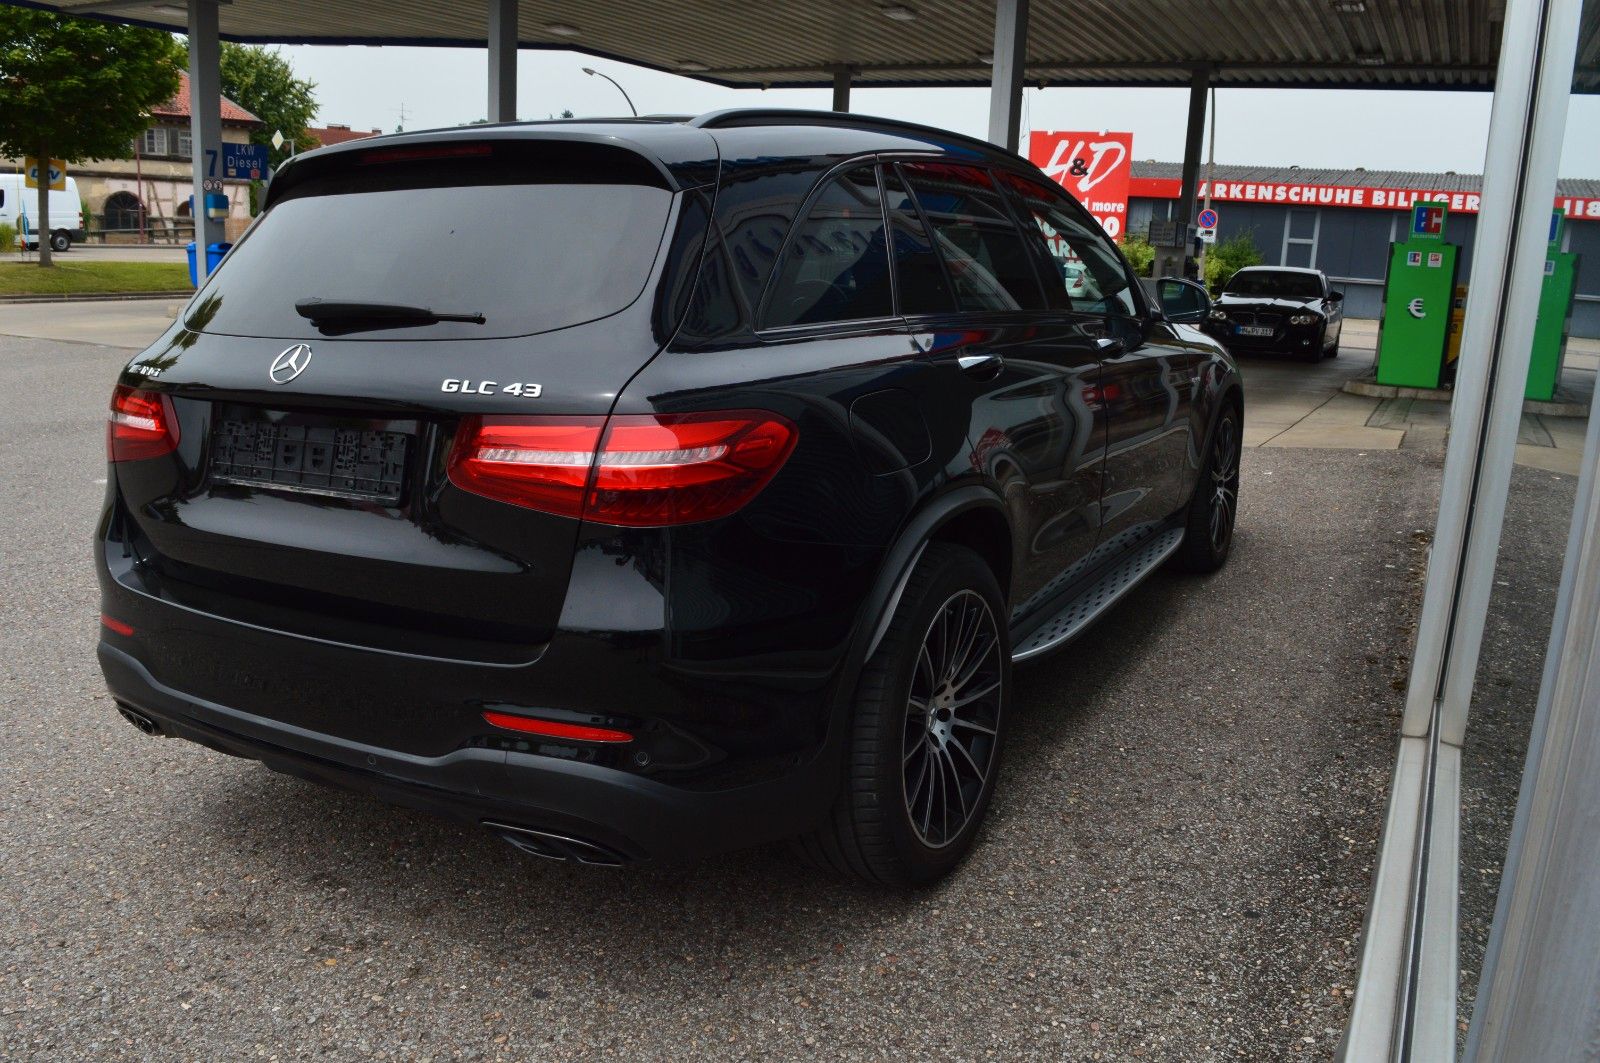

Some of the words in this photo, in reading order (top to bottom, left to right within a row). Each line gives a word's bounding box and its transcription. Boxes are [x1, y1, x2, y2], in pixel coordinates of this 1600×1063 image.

[235, 144, 255, 156] LKW
[205, 149, 217, 177] 7
[227, 155, 261, 169] Diesel
[1038, 139, 1126, 192] H&D
[31, 168, 61, 180] DV
[1179, 183, 1363, 206] ARKENSCHUHE
[1092, 201, 1125, 213] more
[441, 378, 498, 396] GLC
[502, 382, 543, 398] 43
